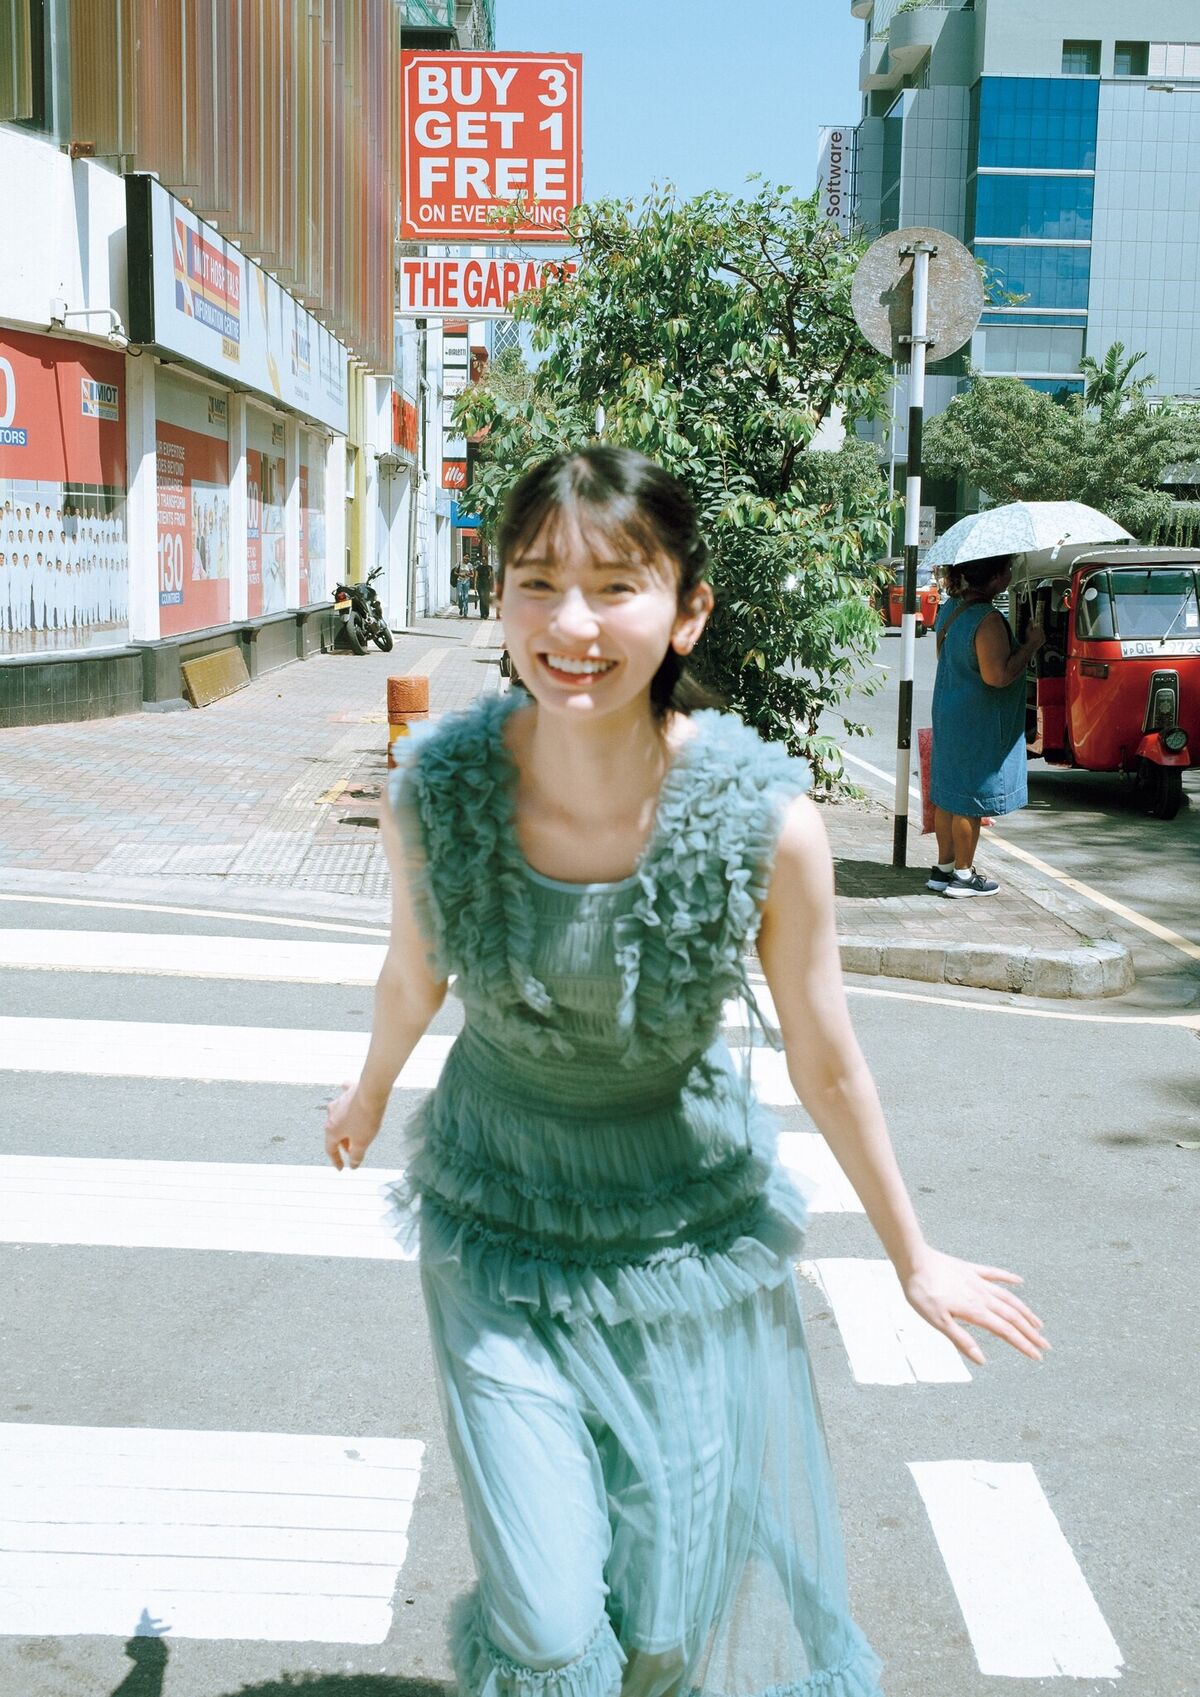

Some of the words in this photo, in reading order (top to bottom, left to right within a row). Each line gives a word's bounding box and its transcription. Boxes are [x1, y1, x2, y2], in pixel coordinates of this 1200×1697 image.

[418, 66, 518, 106] BUY
[537, 69, 568, 107] 3
[414, 110, 524, 149] GET
[539, 112, 563, 151] 1
[419, 157, 567, 200] FREE
[826, 131, 843, 217] Software
[419, 204, 445, 222] ON
[404, 261, 458, 307] THE
[95, 383, 118, 404] MIOT
[445, 466, 465, 485] illy
[157, 532, 184, 593] 130
